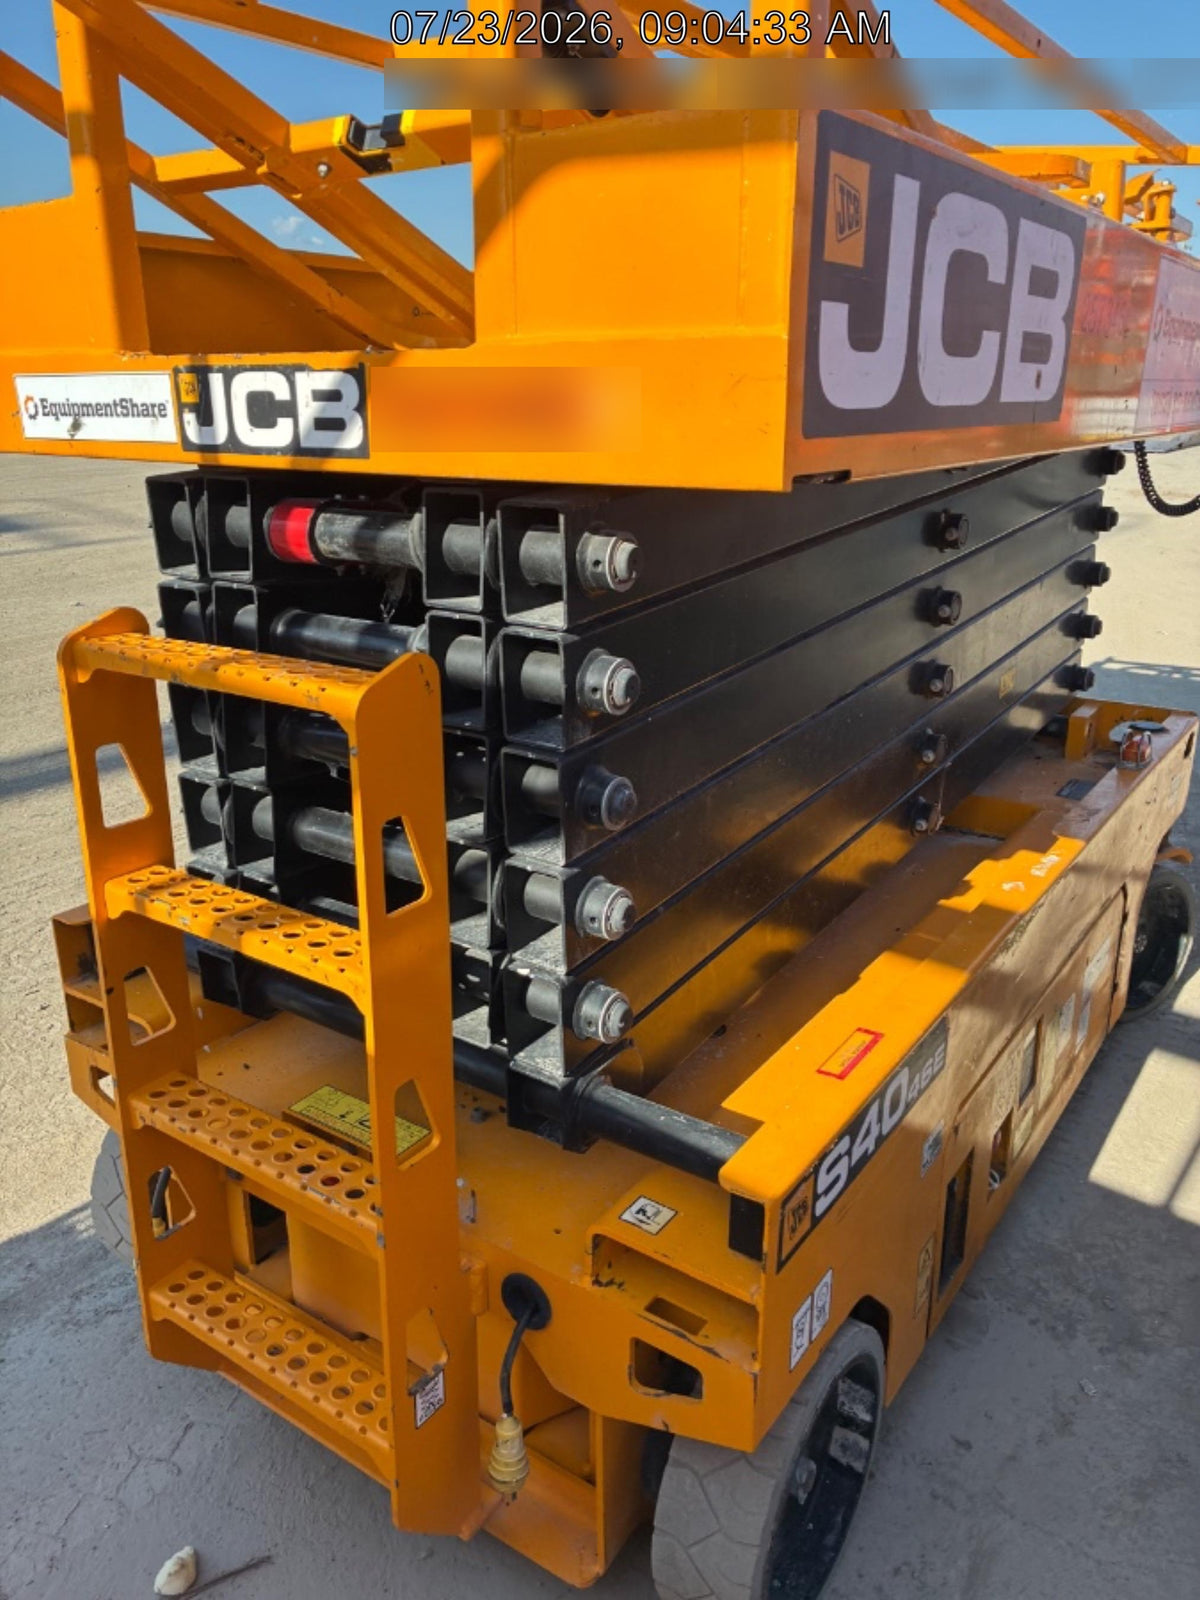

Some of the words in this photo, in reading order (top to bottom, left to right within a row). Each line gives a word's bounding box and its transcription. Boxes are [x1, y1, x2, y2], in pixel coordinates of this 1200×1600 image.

[836, 180, 860, 236] JCB
[818, 173, 1076, 410] JCB
[40, 396, 168, 420] EquipmentShare
[182, 370, 364, 450] JCB
